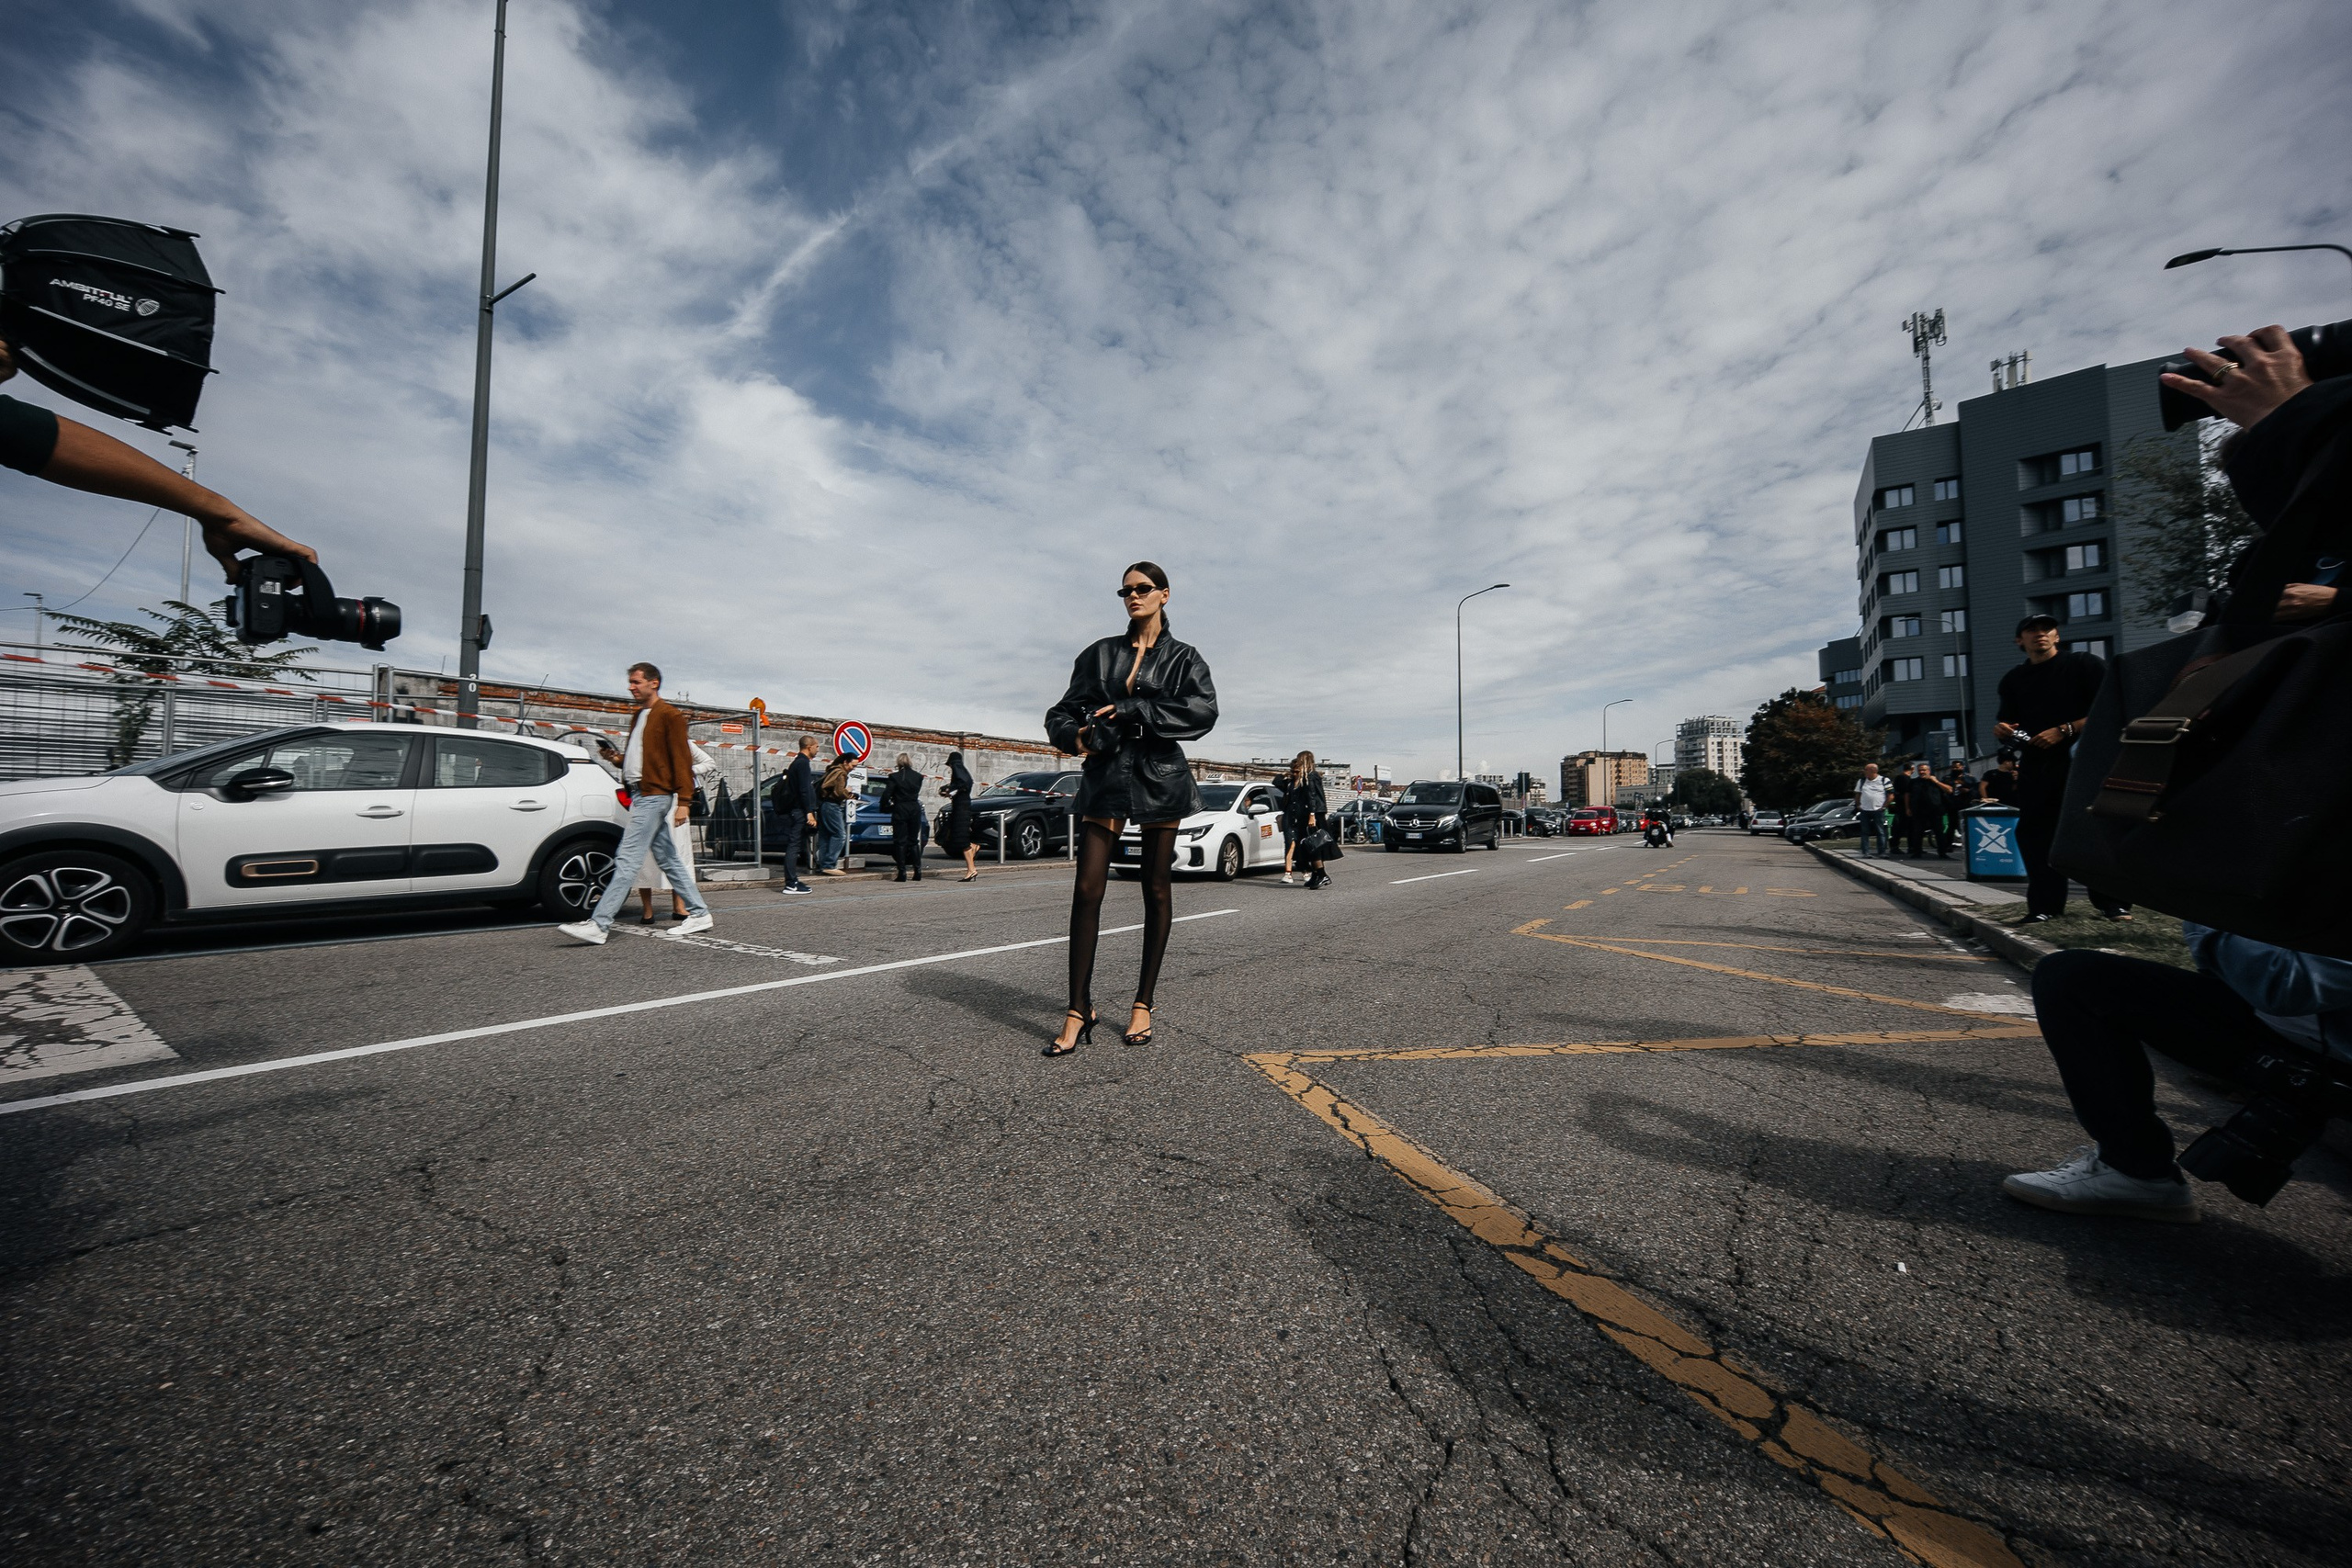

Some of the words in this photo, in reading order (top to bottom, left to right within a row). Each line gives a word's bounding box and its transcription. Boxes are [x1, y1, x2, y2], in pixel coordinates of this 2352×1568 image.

[83, 293, 113, 307] PF40
[114, 301, 131, 311] SE
[1635, 884, 1819, 897] BUS
